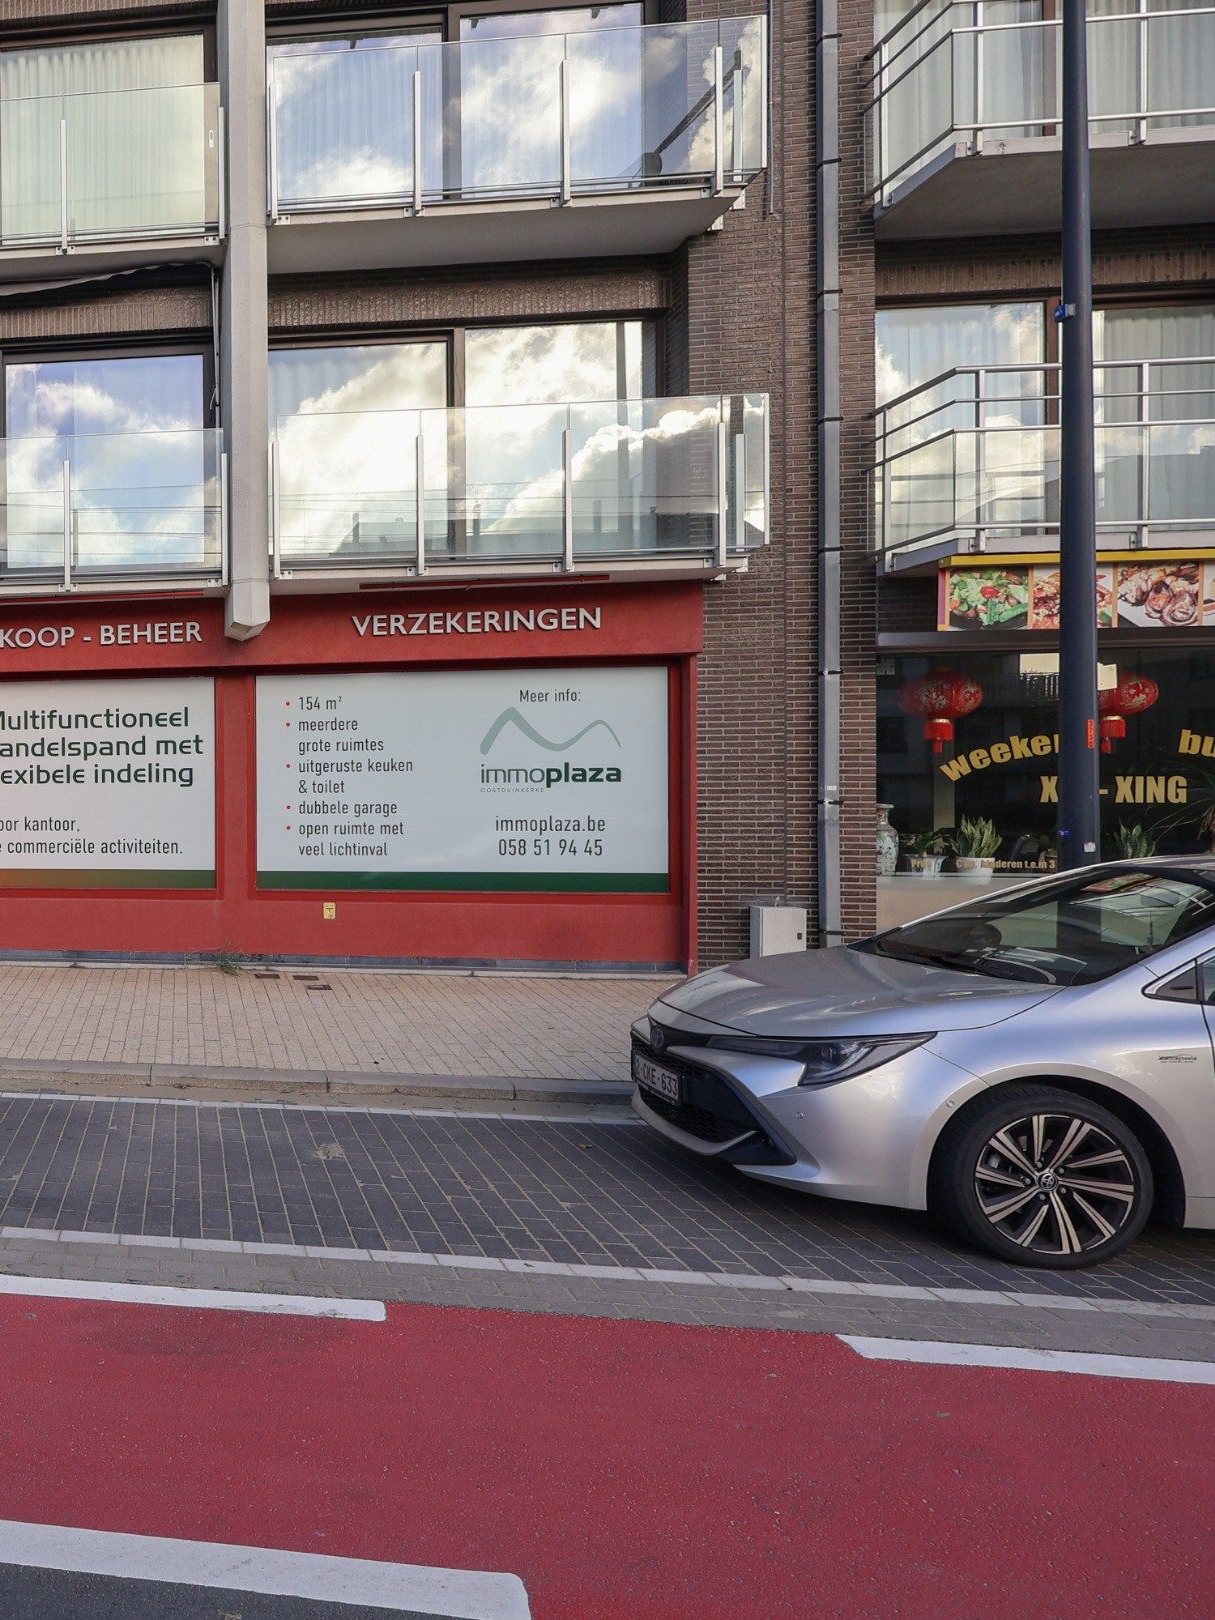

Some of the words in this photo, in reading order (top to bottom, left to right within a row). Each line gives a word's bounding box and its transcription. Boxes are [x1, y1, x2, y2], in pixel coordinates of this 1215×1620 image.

[352, 606, 602, 636] VERZEKERINGEN
[100, 622, 203, 646] BEHEER
[299, 696, 321, 710] 154
[519, 689, 550, 702] Meer
[554, 689, 581, 702] info:
[298, 717, 358, 731] meerdere
[156, 734, 203, 755] met
[298, 739, 331, 755] grote
[336, 738, 384, 751] ruimtes
[94, 763, 193, 788] indeling
[298, 759, 363, 776] uitgeruste
[368, 758, 413, 772] keuken
[481, 762, 622, 788] immoplaza
[298, 780, 308, 793] &
[312, 780, 345, 793] toilet
[1115, 775, 1188, 804] XING
[298, 801, 349, 814] dubbele
[354, 803, 398, 817] garage
[24, 816, 80, 833] kantoor,
[298, 823, 329, 838] open
[333, 822, 375, 835] ruimte
[380, 822, 404, 835] met
[495, 815, 606, 836] immoplaza.be
[7, 839, 95, 855] commerciële
[100, 839, 183, 855] activiteiten.
[298, 843, 325, 856] veel
[329, 843, 388, 856] lichtinval
[498, 839, 527, 856] 058
[533, 839, 551, 856] 51
[558, 839, 577, 856] 94
[583, 839, 603, 856] 45
